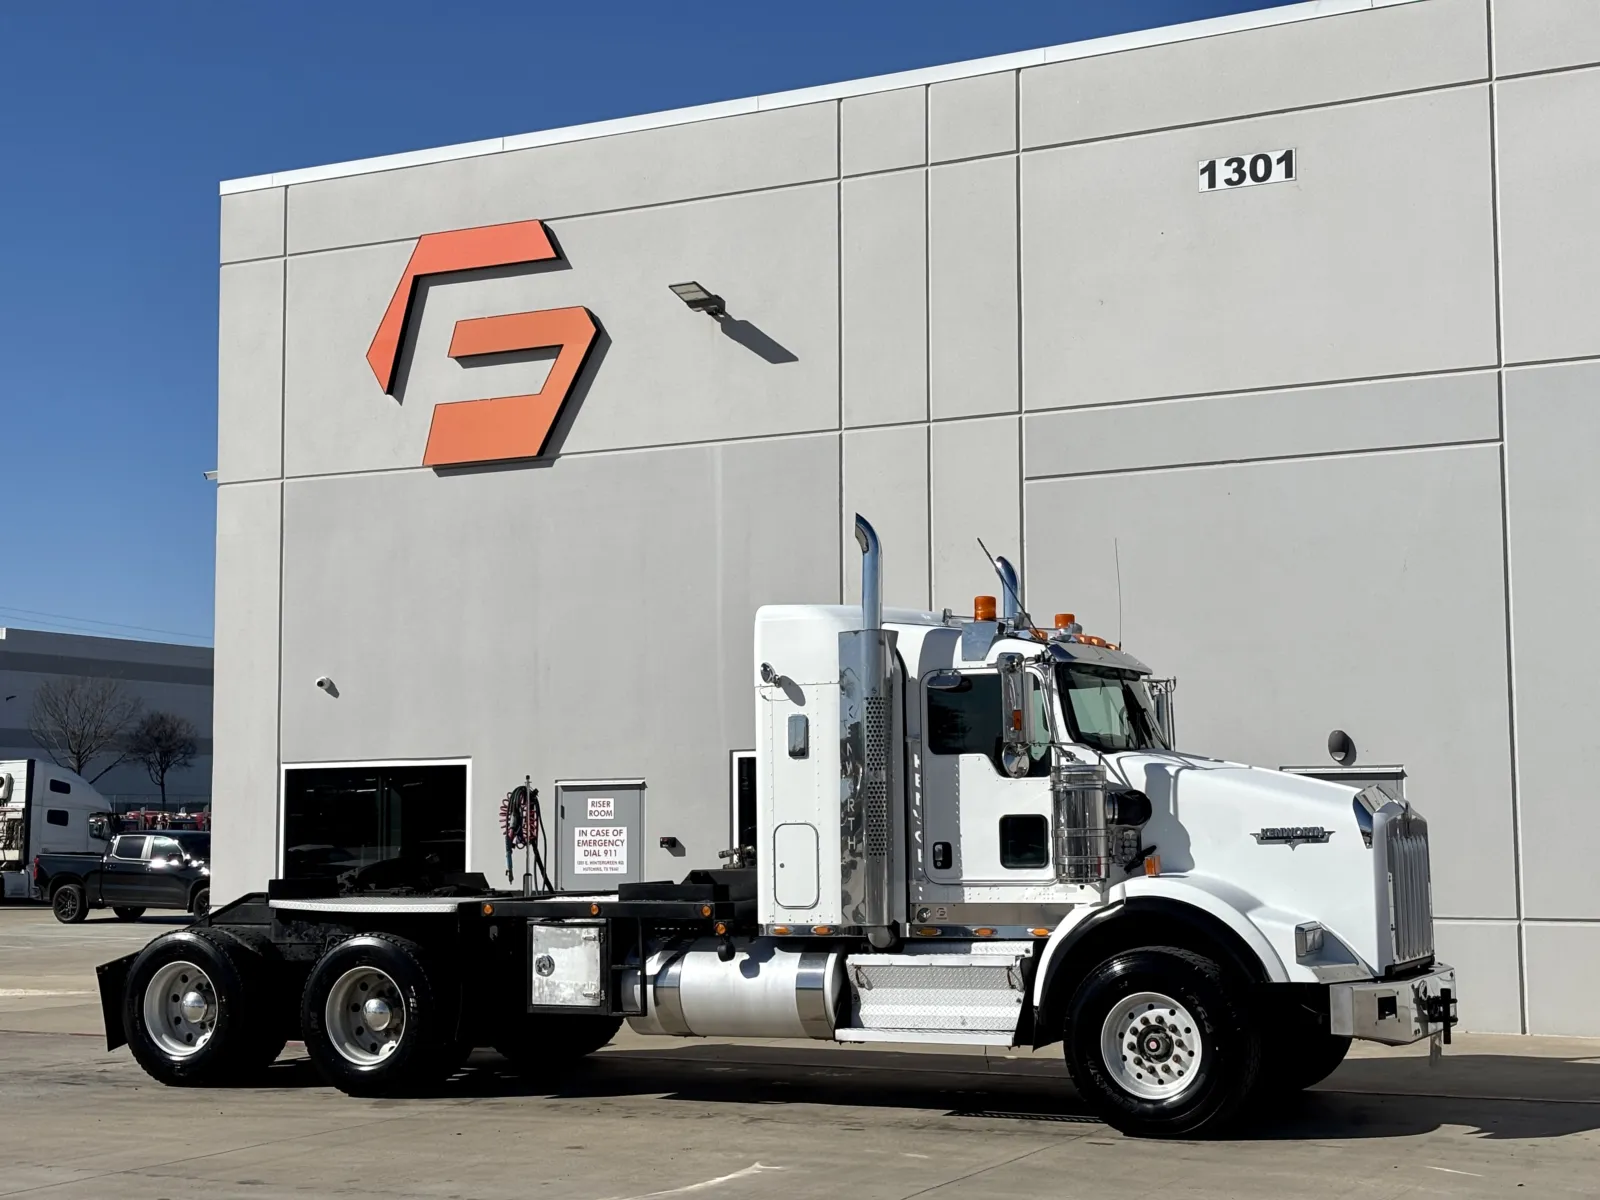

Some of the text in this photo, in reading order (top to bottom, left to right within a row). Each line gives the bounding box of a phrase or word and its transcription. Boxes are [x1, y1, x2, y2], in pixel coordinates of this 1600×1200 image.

[1199, 149, 1293, 189] 1301
[1261, 827, 1324, 838] KENWORTH
[583, 849, 617, 857] DIAL 911
